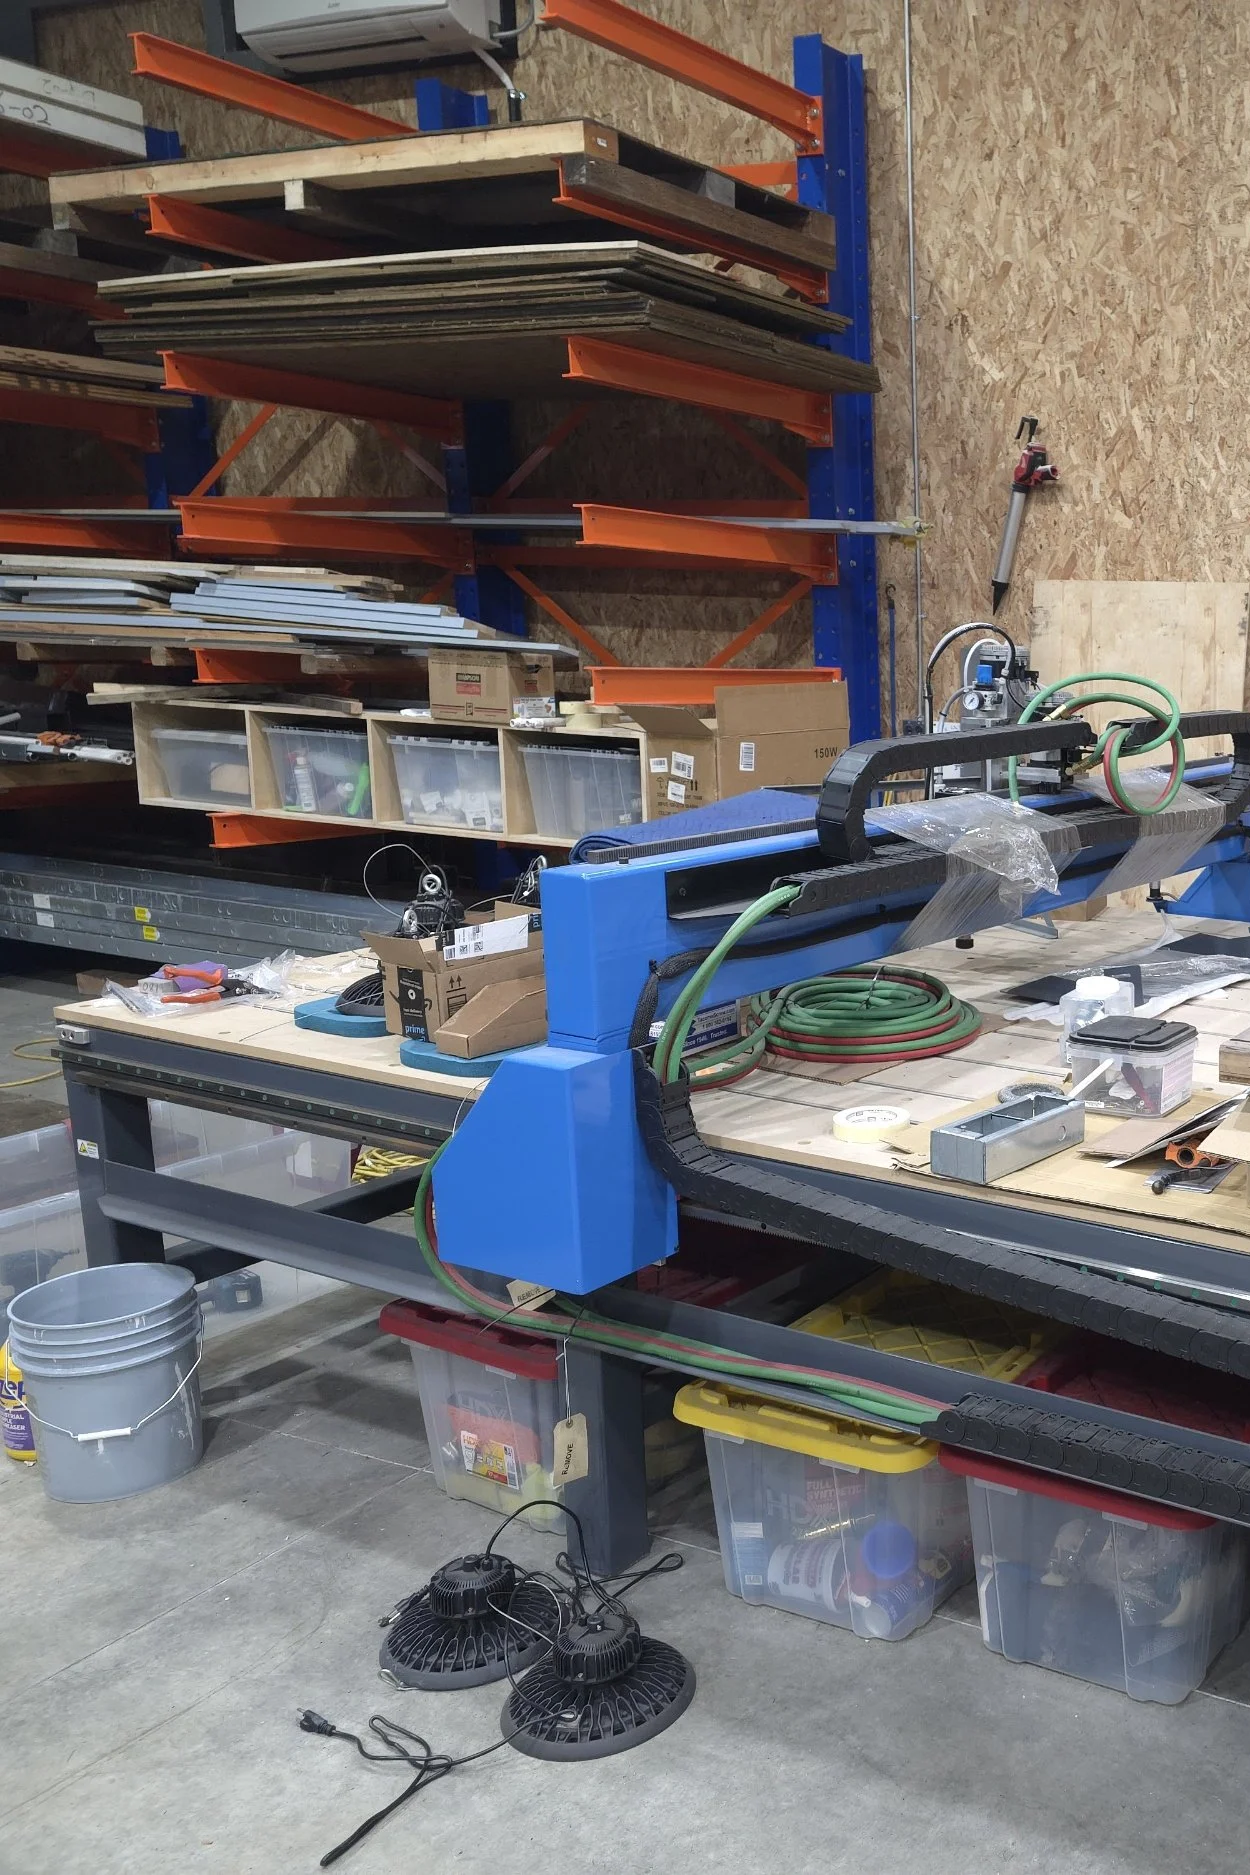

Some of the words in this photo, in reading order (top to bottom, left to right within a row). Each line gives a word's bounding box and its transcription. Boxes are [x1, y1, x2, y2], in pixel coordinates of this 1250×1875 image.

[814, 747, 838, 760] 150W
[405, 1024, 425, 1035] prime
[806, 1480, 833, 1491] FULL
